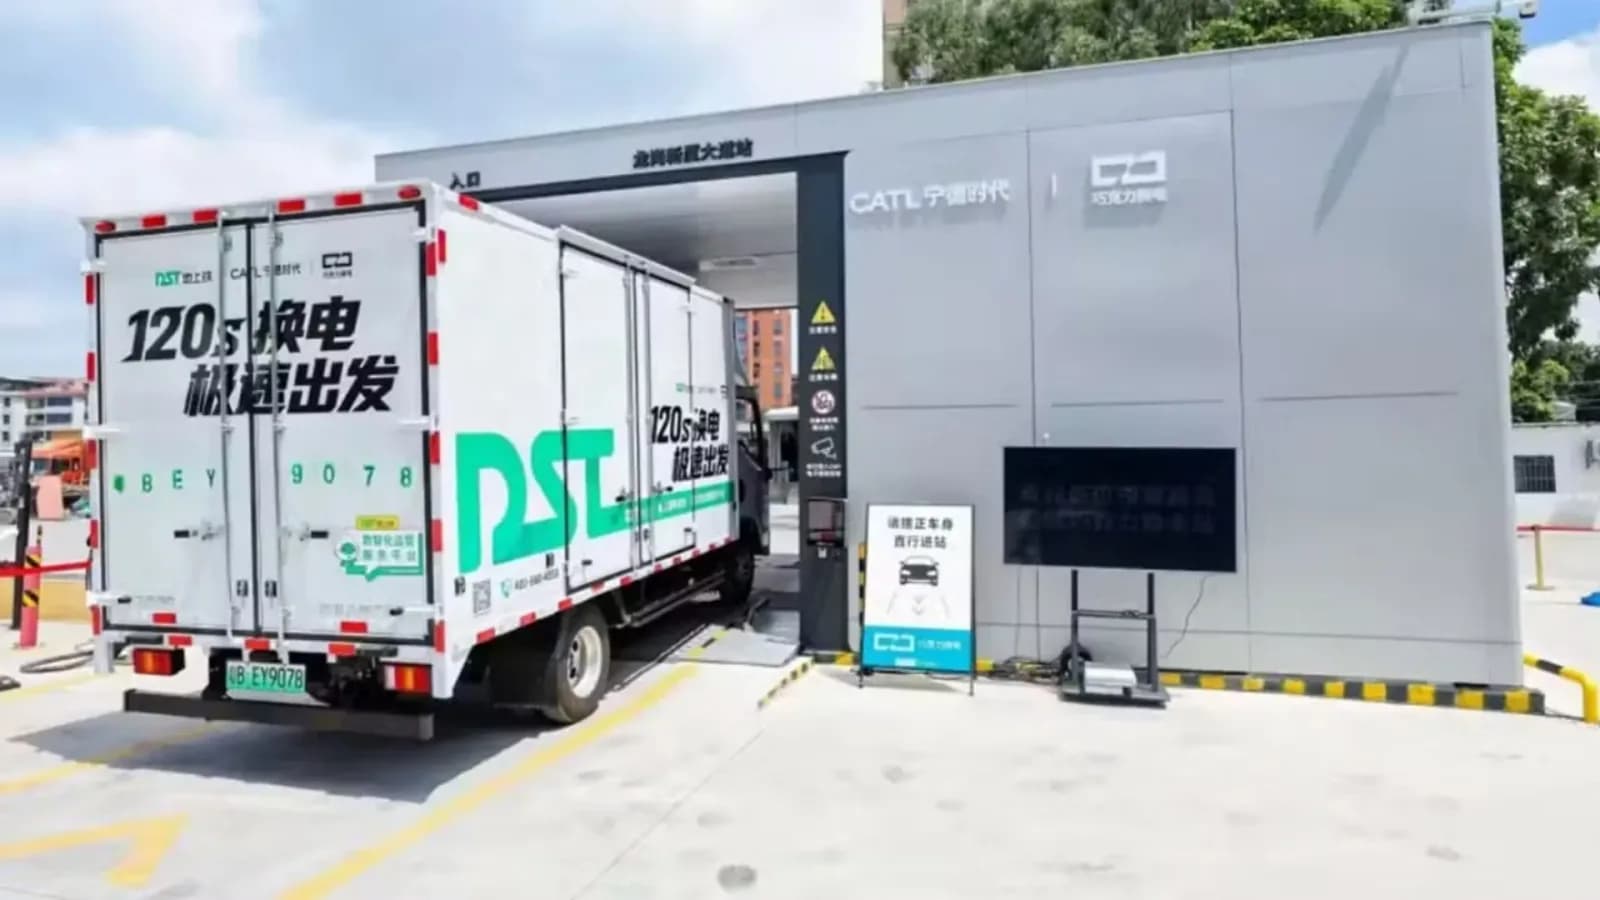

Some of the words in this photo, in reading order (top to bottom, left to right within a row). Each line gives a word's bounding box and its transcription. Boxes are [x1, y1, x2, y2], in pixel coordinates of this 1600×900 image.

[450, 171, 481, 189] 入口
[849, 188, 921, 214] CATL
[923, 178, 1010, 208] 宁德时代
[184, 354, 400, 417] 极速出发
[672, 443, 730, 483] 极速出发
[456, 428, 615, 575] DST
[894, 534, 947, 549] 直行进站
